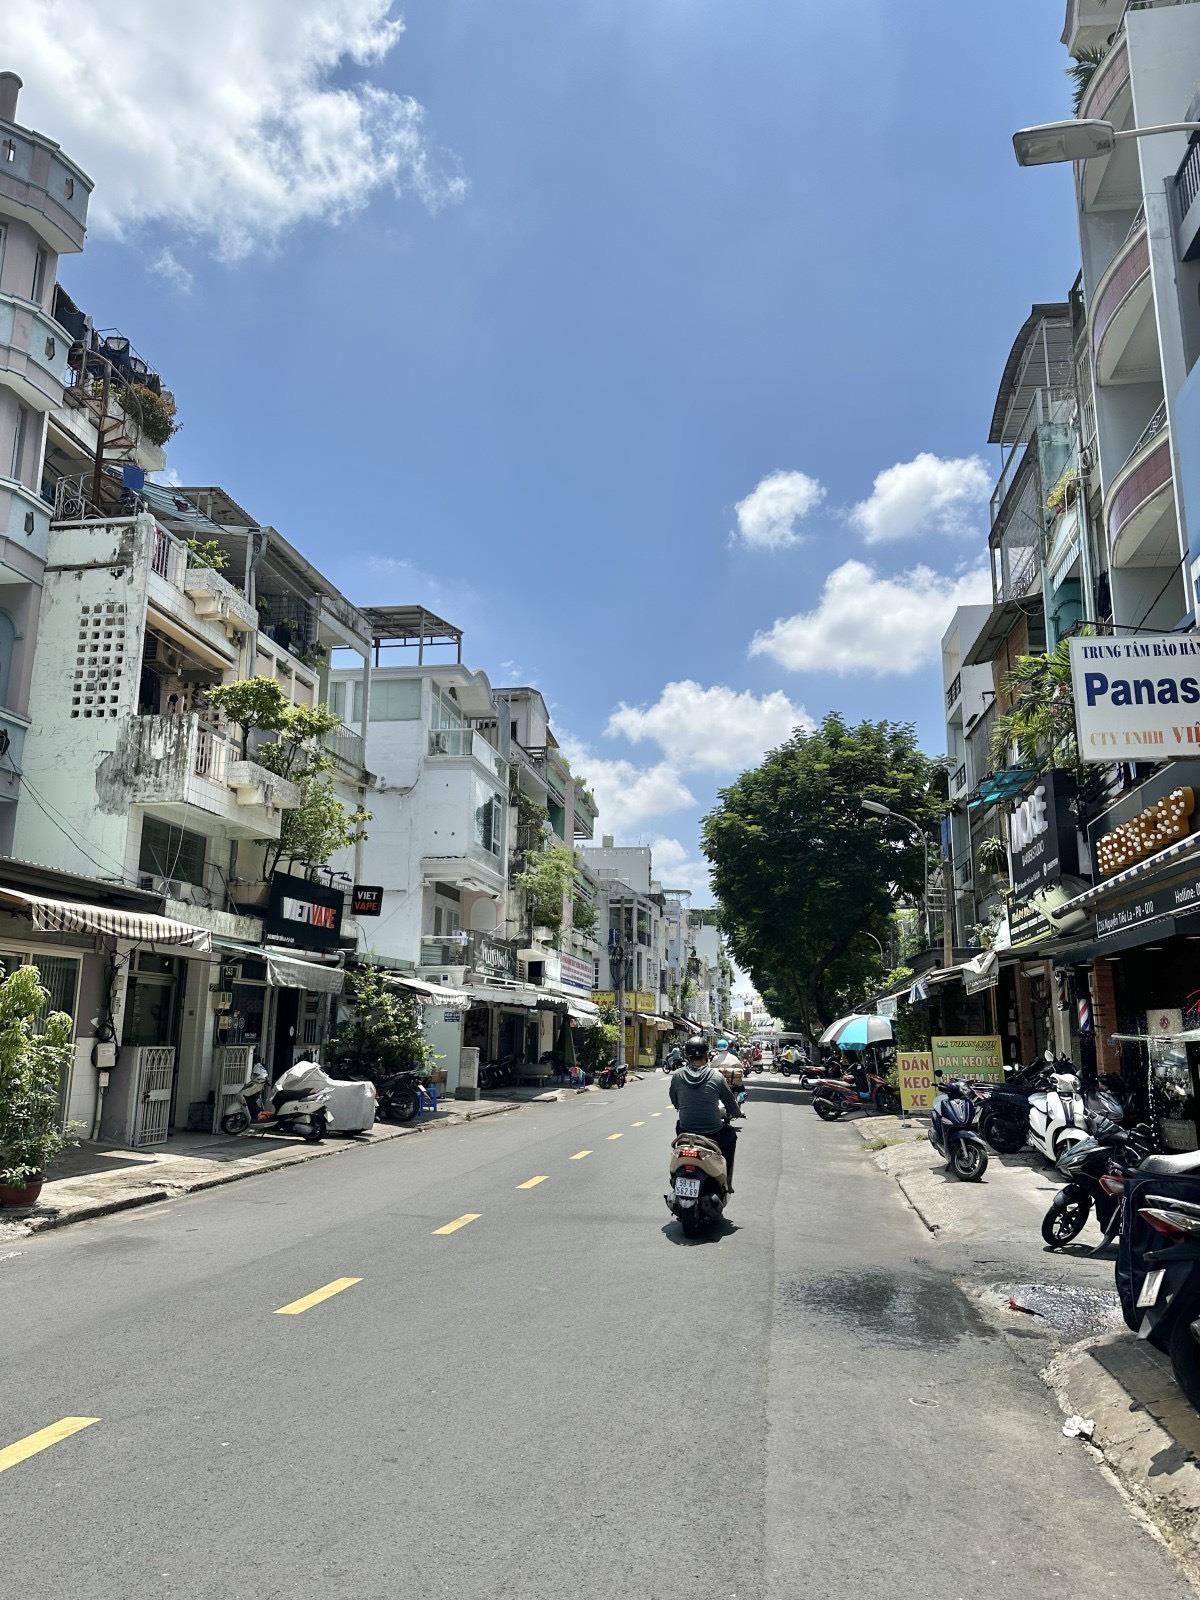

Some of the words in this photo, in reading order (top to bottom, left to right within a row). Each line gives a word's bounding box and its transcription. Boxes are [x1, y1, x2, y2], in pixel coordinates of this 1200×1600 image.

[1082, 645, 1121, 659] TRUNG
[1124, 641, 1150, 658] TÂM
[1152, 639, 1177, 657] BẢO
[1090, 731, 1118, 746] CTY
[1122, 730, 1164, 745] TNHH
[357, 891, 378, 901] VIET
[1174, 887, 1196, 904] Hotline:
[354, 902, 378, 911] VAPE
[901, 1056, 930, 1071] DÁN
[962, 1056, 983, 1067] KEO
[986, 1056, 999, 1067] XE
[903, 1077, 930, 1089] KEO
[910, 1094, 928, 1107] XE
